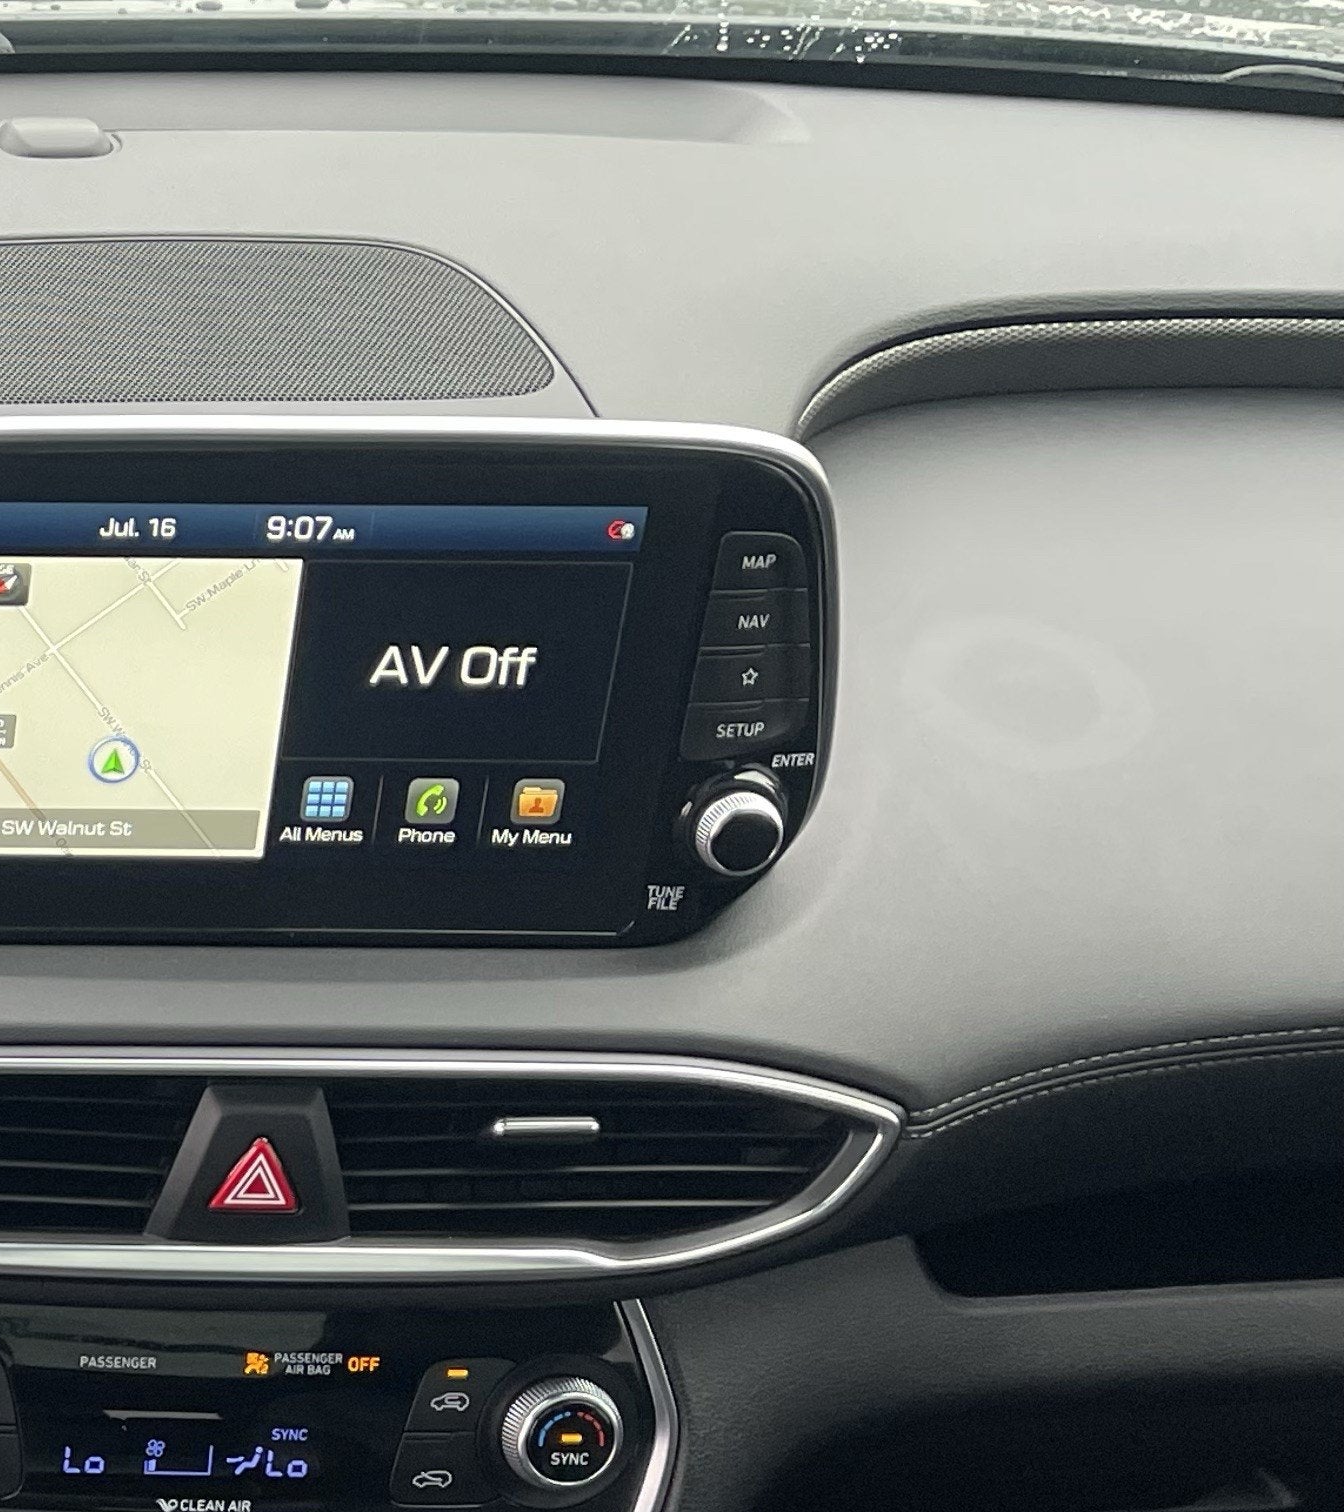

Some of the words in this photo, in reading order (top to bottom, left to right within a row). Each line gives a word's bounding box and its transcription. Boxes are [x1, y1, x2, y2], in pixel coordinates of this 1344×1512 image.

[99, 518, 140, 539] Jul.
[149, 518, 177, 539] 16
[266, 515, 333, 541] 9:07
[333, 528, 355, 541] AM
[742, 554, 777, 569] MAP
[203, 566, 244, 602] Maple
[738, 614, 770, 630] NAV
[369, 646, 450, 686] AV
[460, 646, 538, 687] Off
[716, 722, 765, 738] SETUP
[771, 753, 815, 768] ENTER
[1, 821, 34, 836] SW
[36, 819, 106, 836] Walnut
[109, 820, 132, 836] St
[280, 826, 303, 842] All
[304, 827, 363, 842] Menus
[398, 829, 456, 844] Phone
[491, 829, 520, 847] My
[522, 830, 572, 845] Menu
[647, 885, 685, 899] TUNE
[647, 898, 678, 911] FILE
[79, 1356, 157, 1369] PASSENGER
[274, 1352, 343, 1366] PASSENGER
[347, 1356, 380, 1373] OFF
[285, 1364, 305, 1375] AIR
[307, 1364, 331, 1376] BAG
[271, 1428, 309, 1442] SYNC
[550, 1452, 589, 1466] SYNC
[180, 1499, 225, 1512] CLEAN
[227, 1500, 252, 1512] AIR
